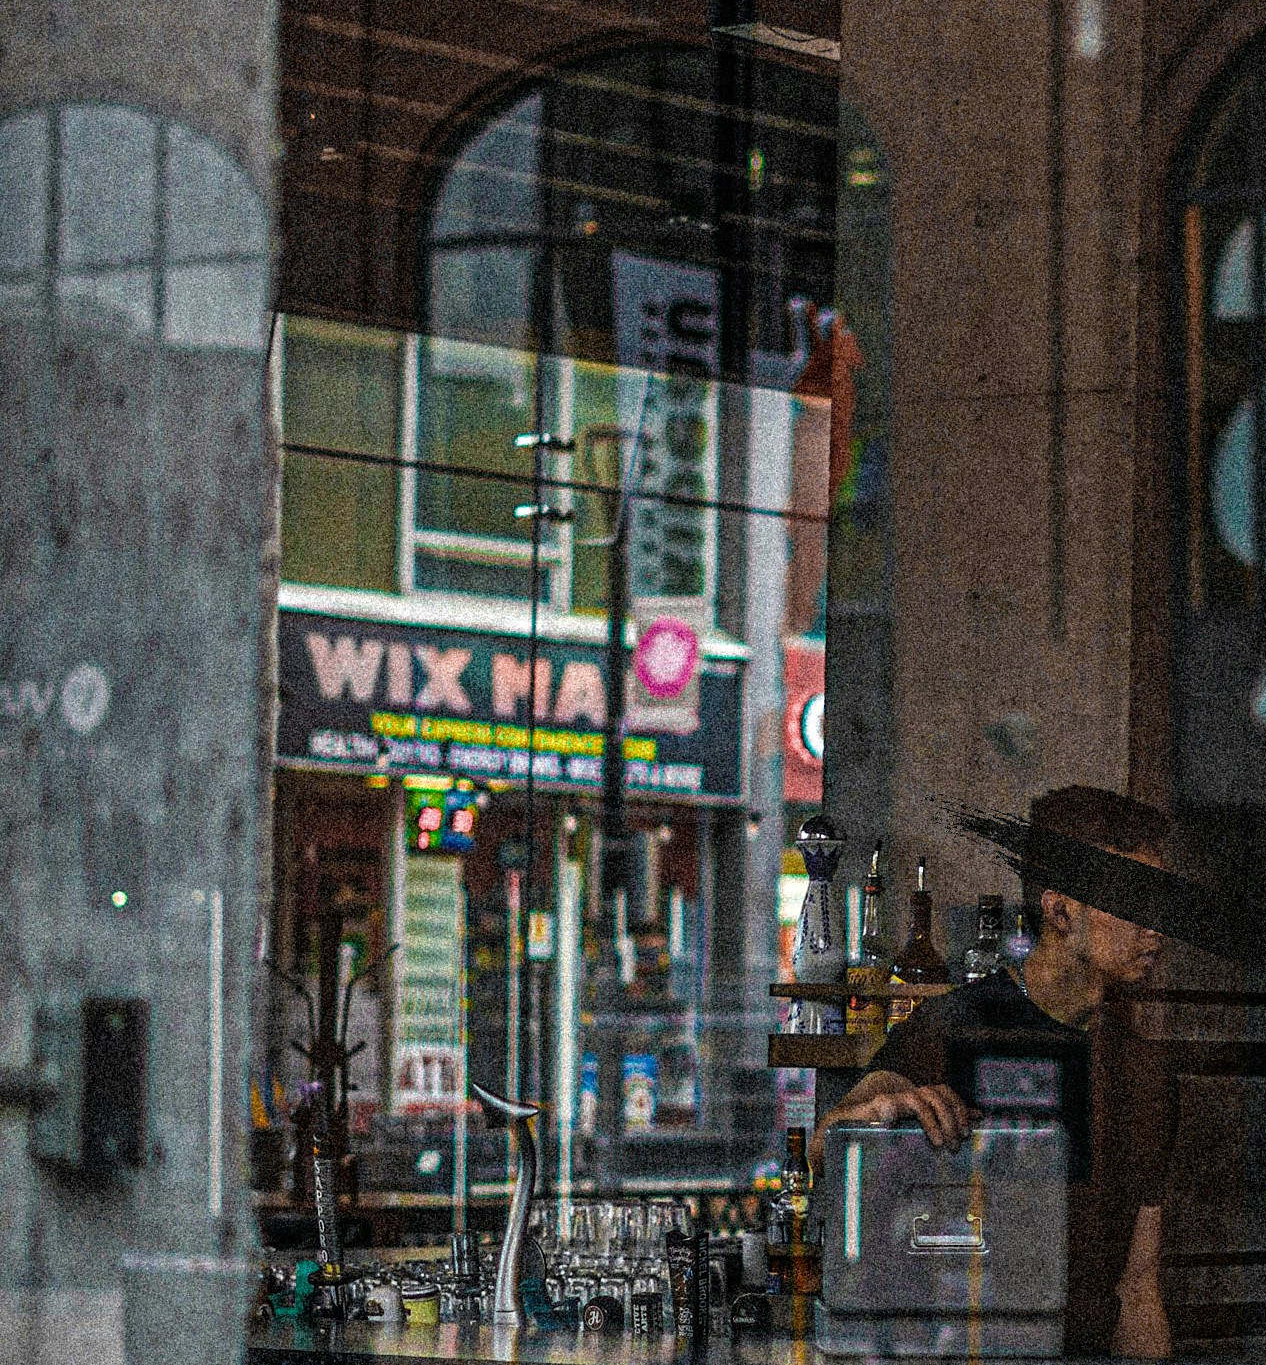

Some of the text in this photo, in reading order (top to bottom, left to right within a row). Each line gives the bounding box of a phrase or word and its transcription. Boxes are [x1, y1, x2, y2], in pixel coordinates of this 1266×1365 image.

[304, 632, 472, 714] WIX
[313, 1160, 328, 1263] SAPPORO
[698, 1237, 708, 1276] NICKEL
[698, 1278, 708, 1315] BROOK
